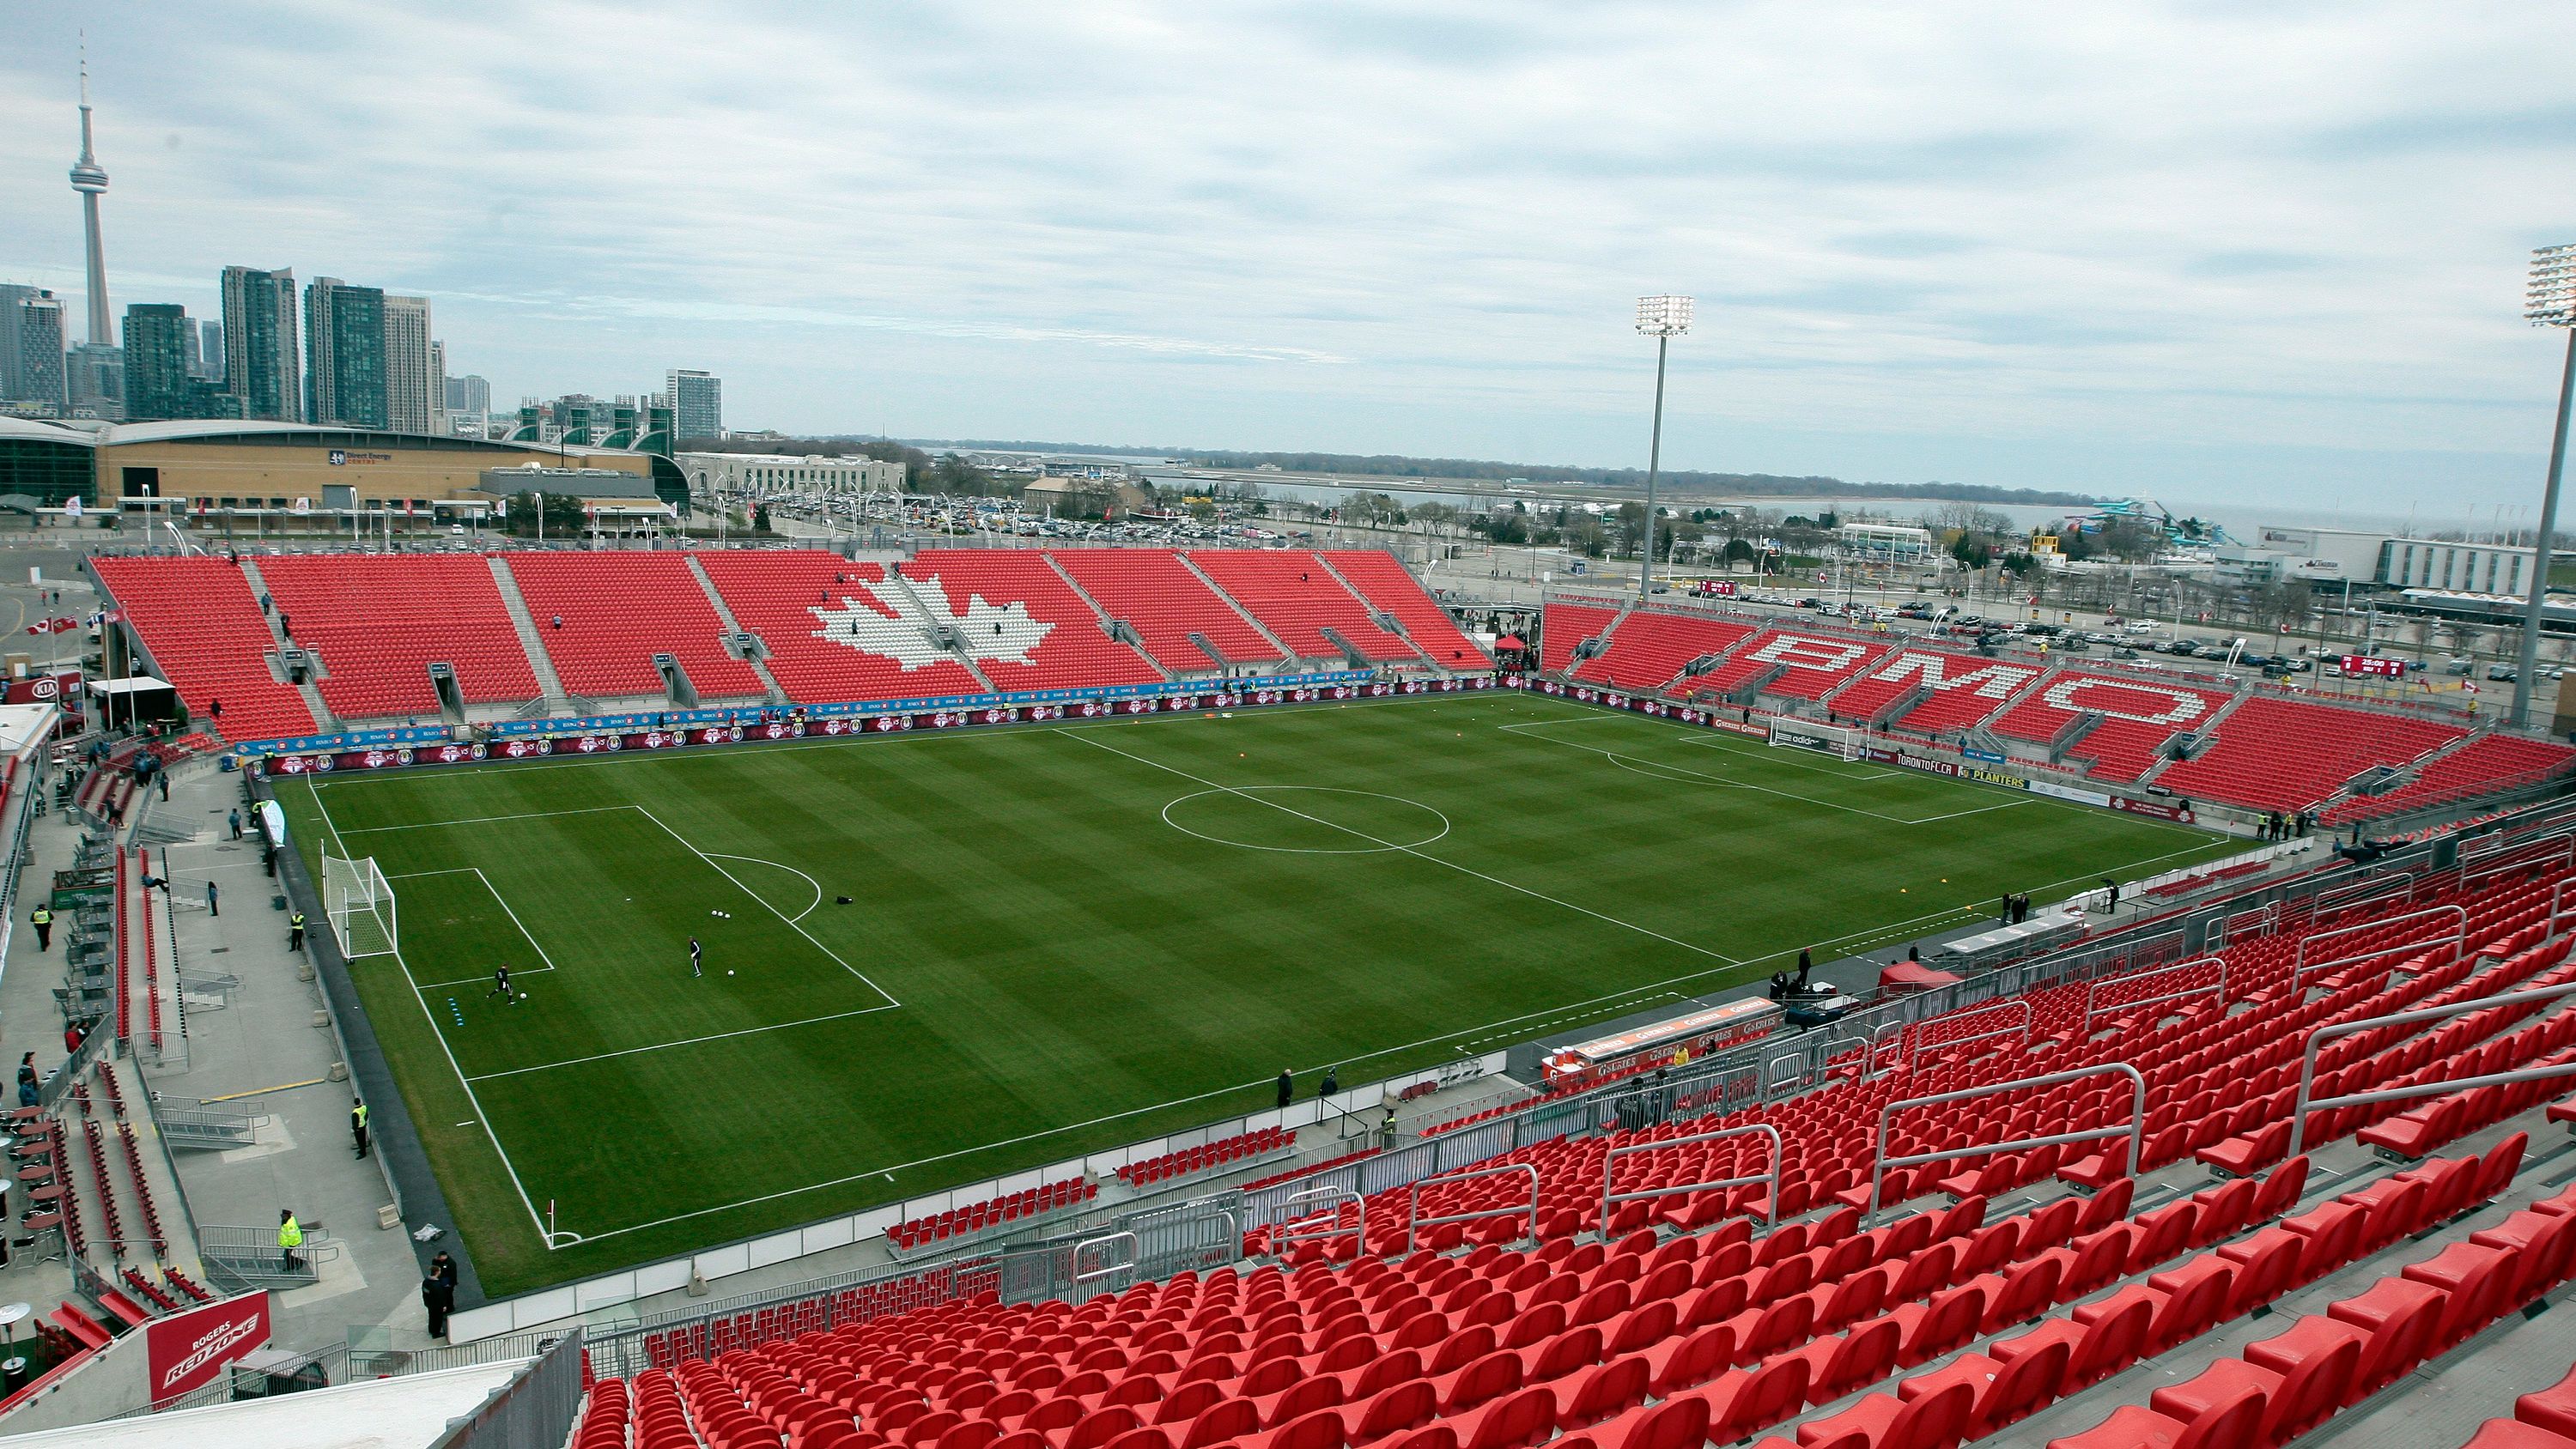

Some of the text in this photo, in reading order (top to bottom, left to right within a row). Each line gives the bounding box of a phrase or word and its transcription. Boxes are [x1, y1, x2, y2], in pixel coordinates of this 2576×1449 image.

[2361, 658, 2385, 667] 25:00
[1745, 634, 2207, 724] BMO
[36, 684, 54, 695] KIA
[1898, 754, 1952, 774] TORONTOFC.CA
[1973, 770, 2025, 787] PLANTERS
[192, 1320, 231, 1350] ROGERS
